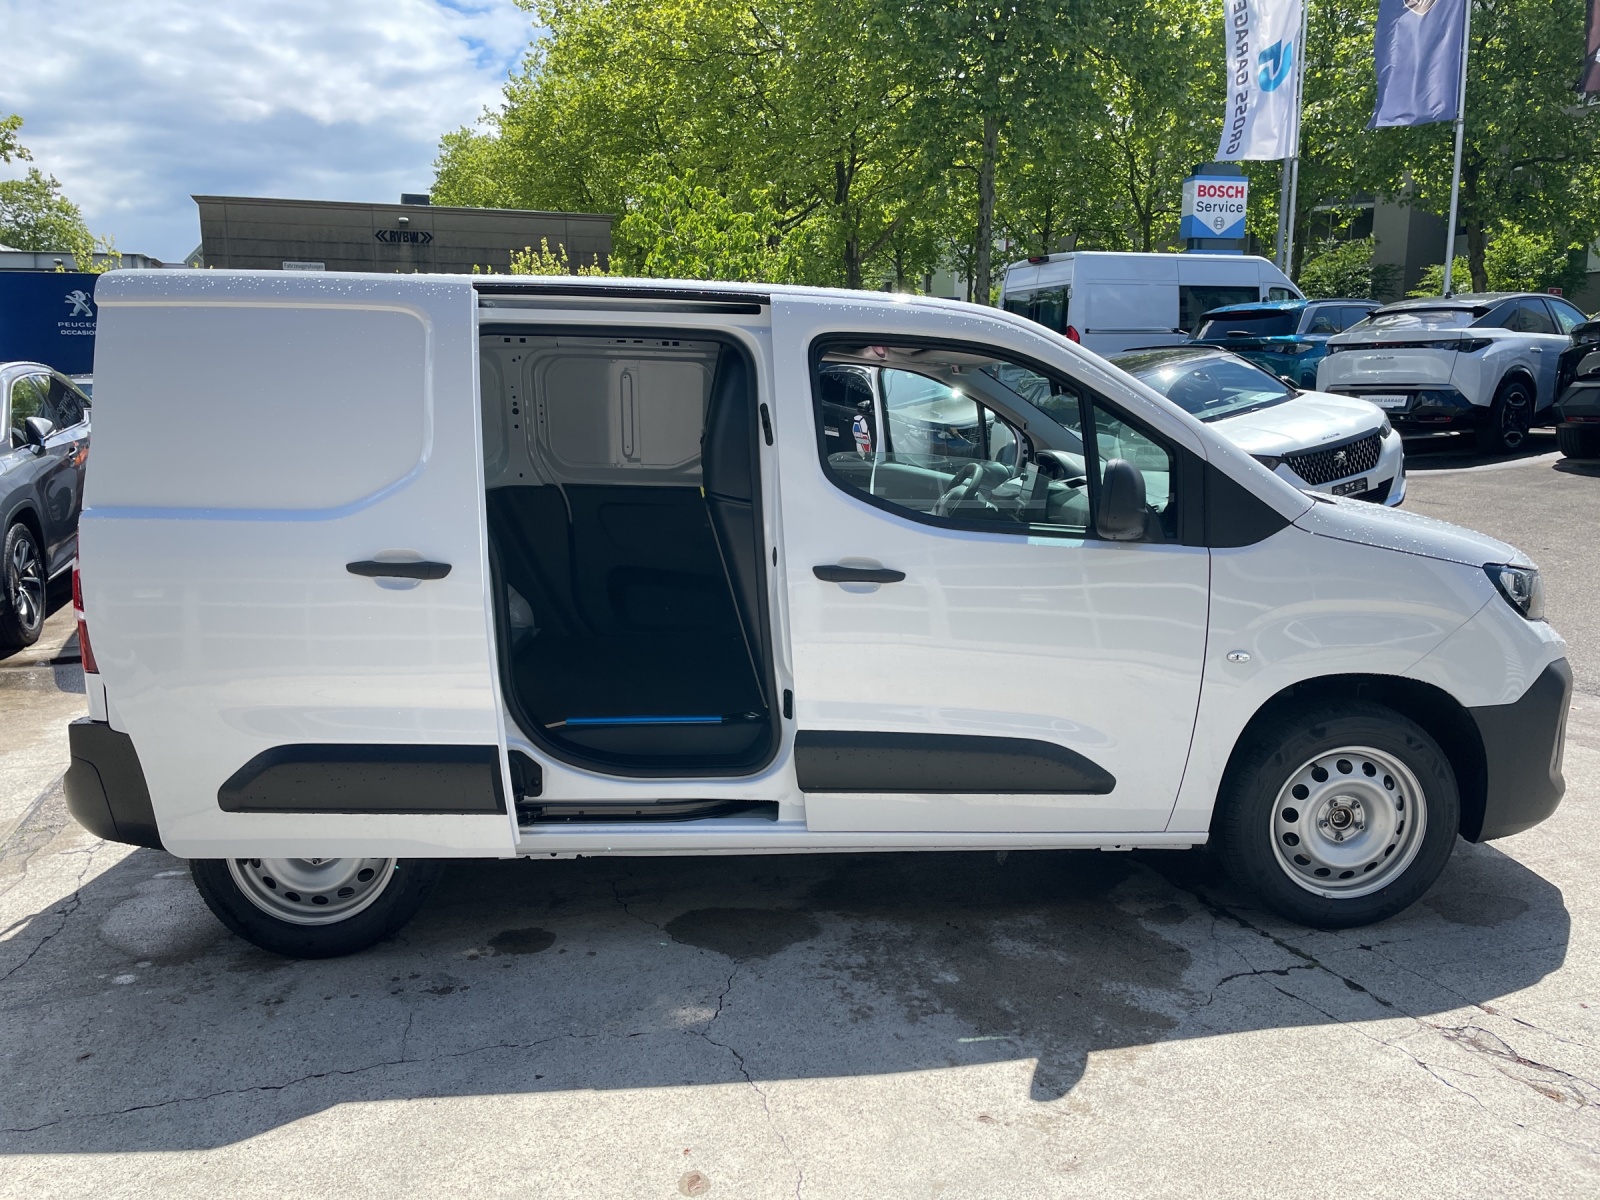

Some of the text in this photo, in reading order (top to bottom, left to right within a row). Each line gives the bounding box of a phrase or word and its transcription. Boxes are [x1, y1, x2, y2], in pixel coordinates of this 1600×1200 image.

[1197, 184, 1245, 199] BOSCH
[1195, 200, 1244, 213] Service
[389, 230, 419, 243] RVBW
